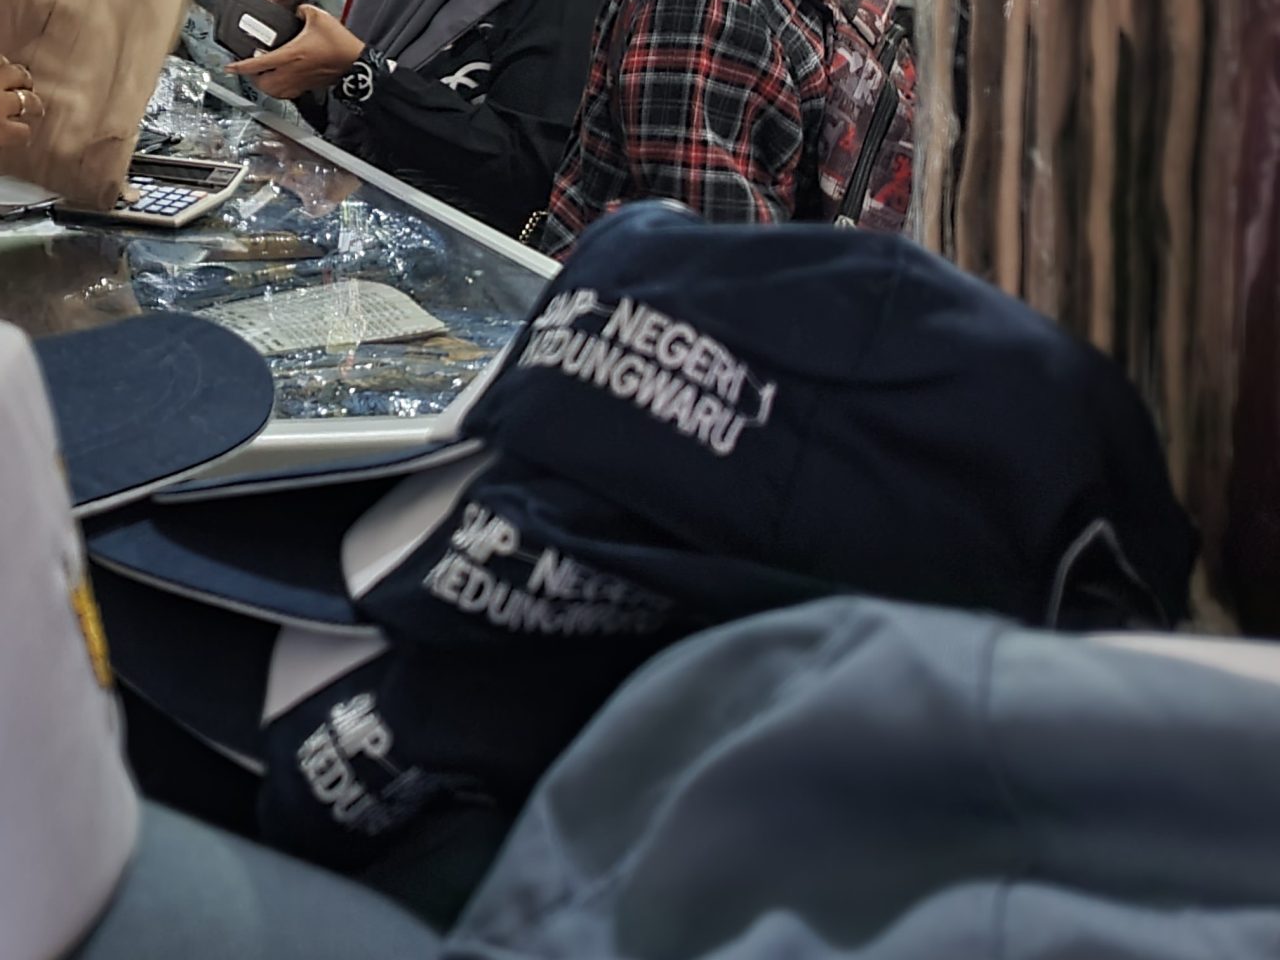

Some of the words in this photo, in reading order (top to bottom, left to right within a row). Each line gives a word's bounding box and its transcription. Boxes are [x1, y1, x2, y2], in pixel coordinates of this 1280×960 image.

[533, 288, 598, 331] SMP
[601, 296, 747, 405] NEGERI
[451, 501, 520, 564] SMP
